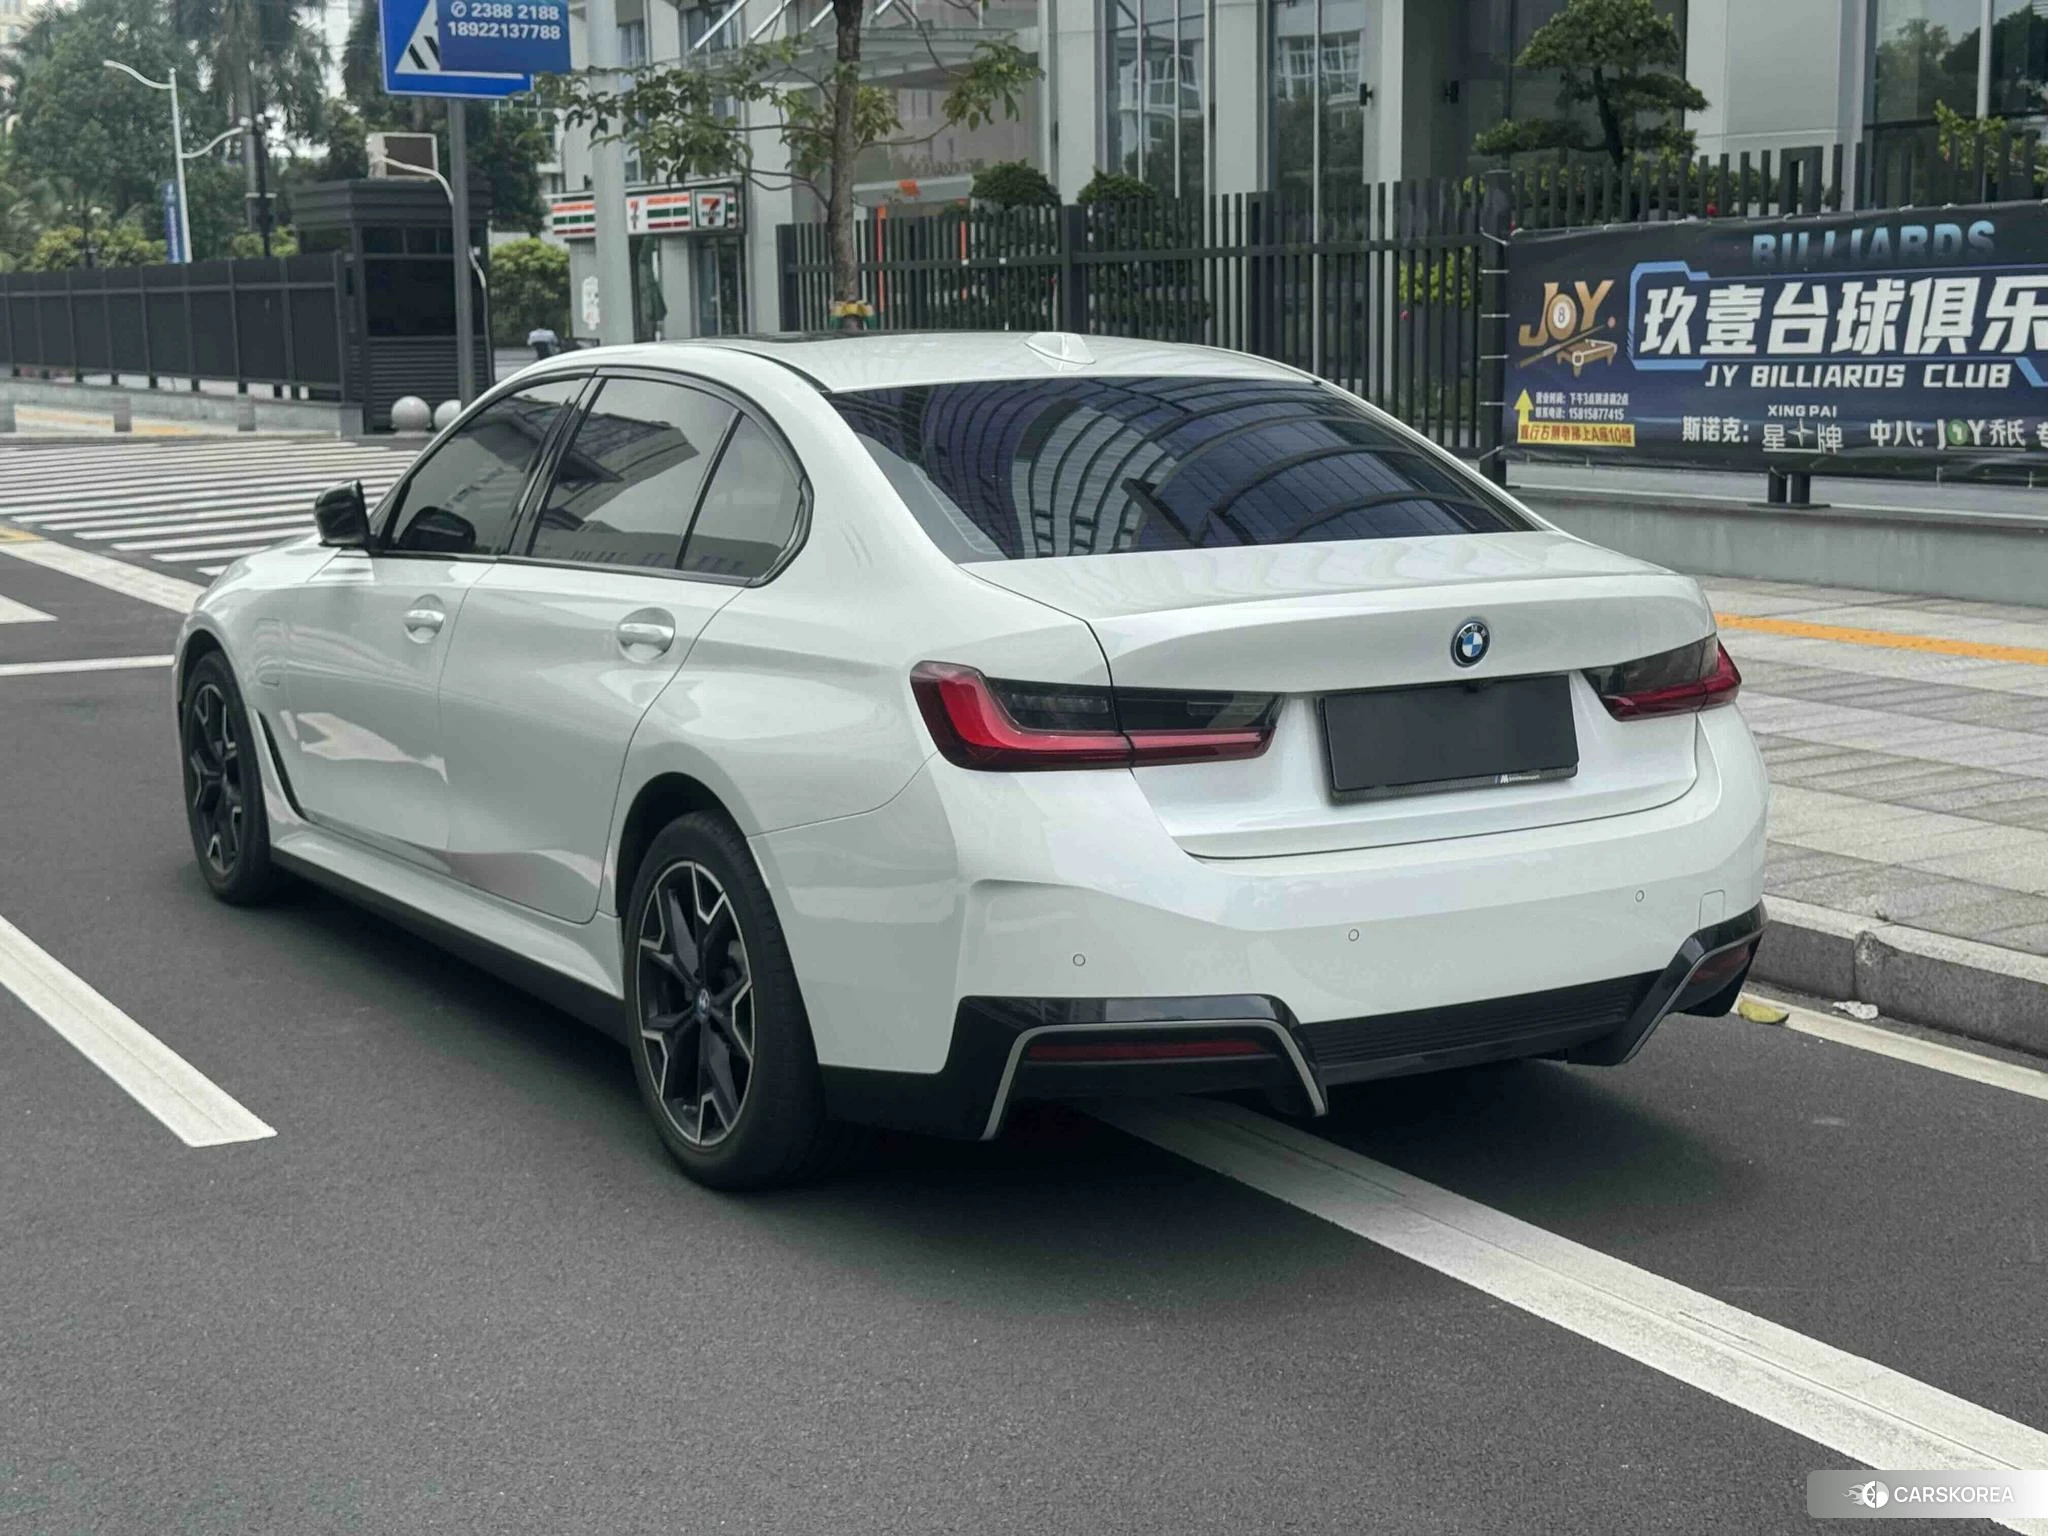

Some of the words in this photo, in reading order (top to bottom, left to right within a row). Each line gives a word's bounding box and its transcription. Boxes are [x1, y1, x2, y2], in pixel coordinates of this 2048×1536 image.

[471, 2, 513, 19] 2388
[517, 5, 560, 20] 2188
[448, 21, 561, 40] 18922137788
[702, 197, 721, 225] 7
[1752, 219, 1996, 265] BILLIARDS
[1518, 279, 1615, 347] JOY
[1640, 276, 2048, 355] 玖壹台球俱乐
[1705, 366, 1738, 388] JY
[1750, 364, 1905, 388] BILLIARDS
[1923, 363, 2012, 388] CLUB
[1768, 405, 1805, 417] XING
[1810, 405, 1837, 418] PAI
